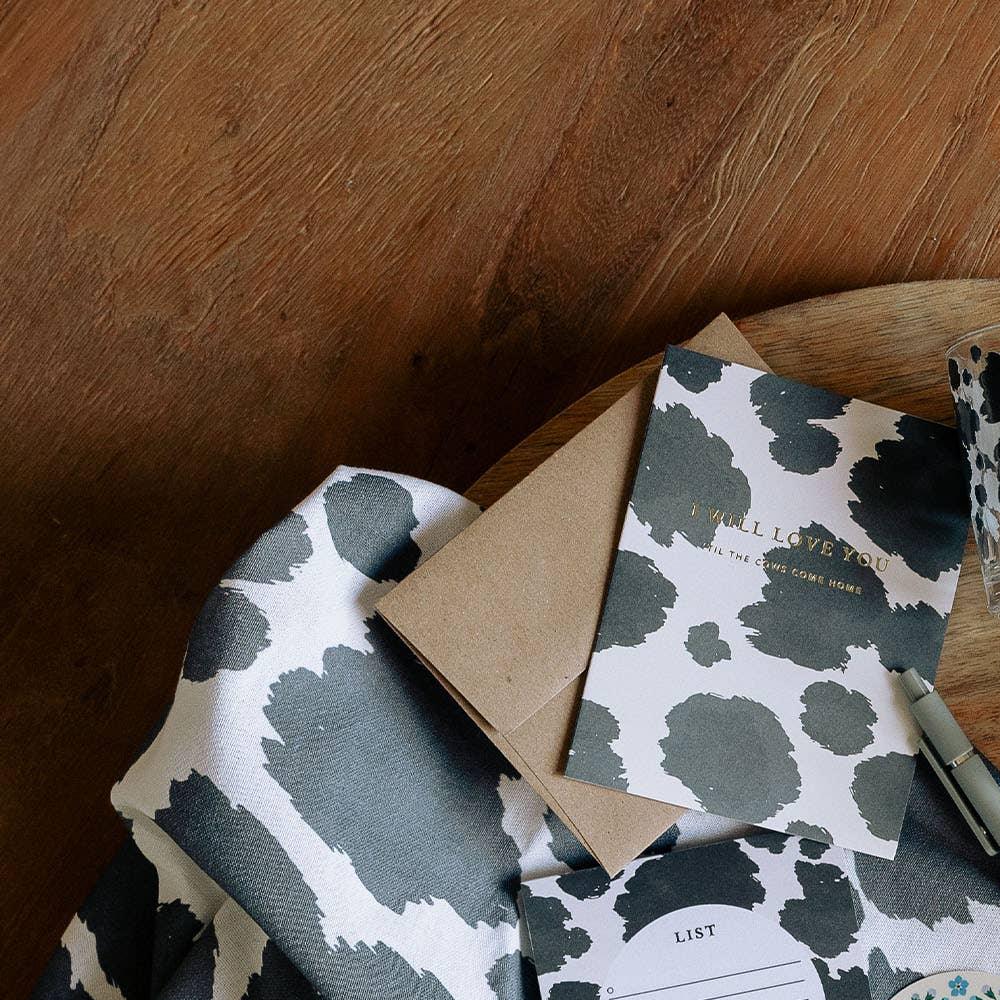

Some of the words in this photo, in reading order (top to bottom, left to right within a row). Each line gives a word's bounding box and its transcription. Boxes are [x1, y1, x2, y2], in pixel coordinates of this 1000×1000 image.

[708, 506, 764, 537] WILL
[772, 527, 834, 557] LOVE
[842, 546, 890, 572] YOU
[729, 550, 751, 563] THE
[755, 559, 787, 574] COWS
[791, 568, 825, 585] COME
[829, 579, 864, 595] HOME
[674, 924, 716, 943] LIST
